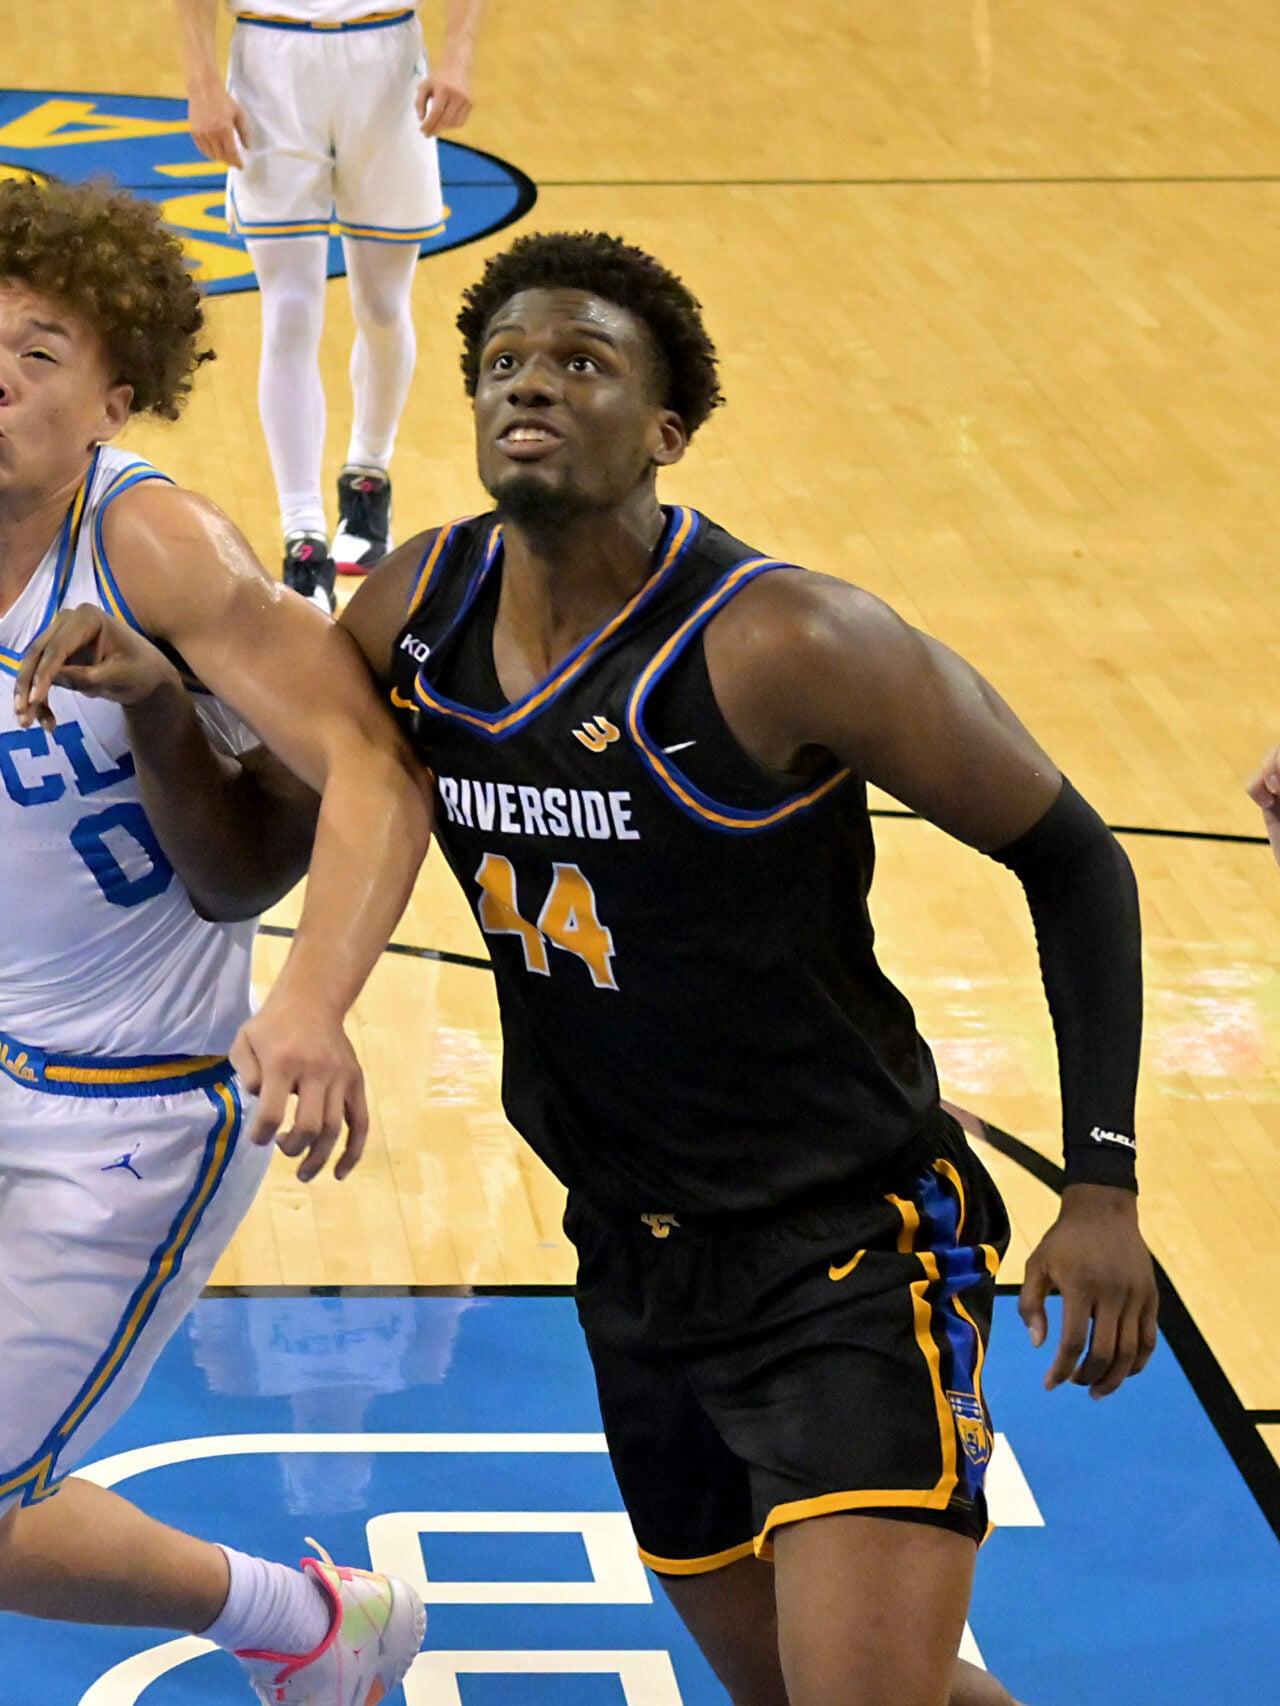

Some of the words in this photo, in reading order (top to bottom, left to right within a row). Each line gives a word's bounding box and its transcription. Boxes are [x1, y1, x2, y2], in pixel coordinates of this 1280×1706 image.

[69, 802, 175, 908] 0
[438, 775, 641, 841] RIVERSIDE
[474, 852, 620, 991] 44
